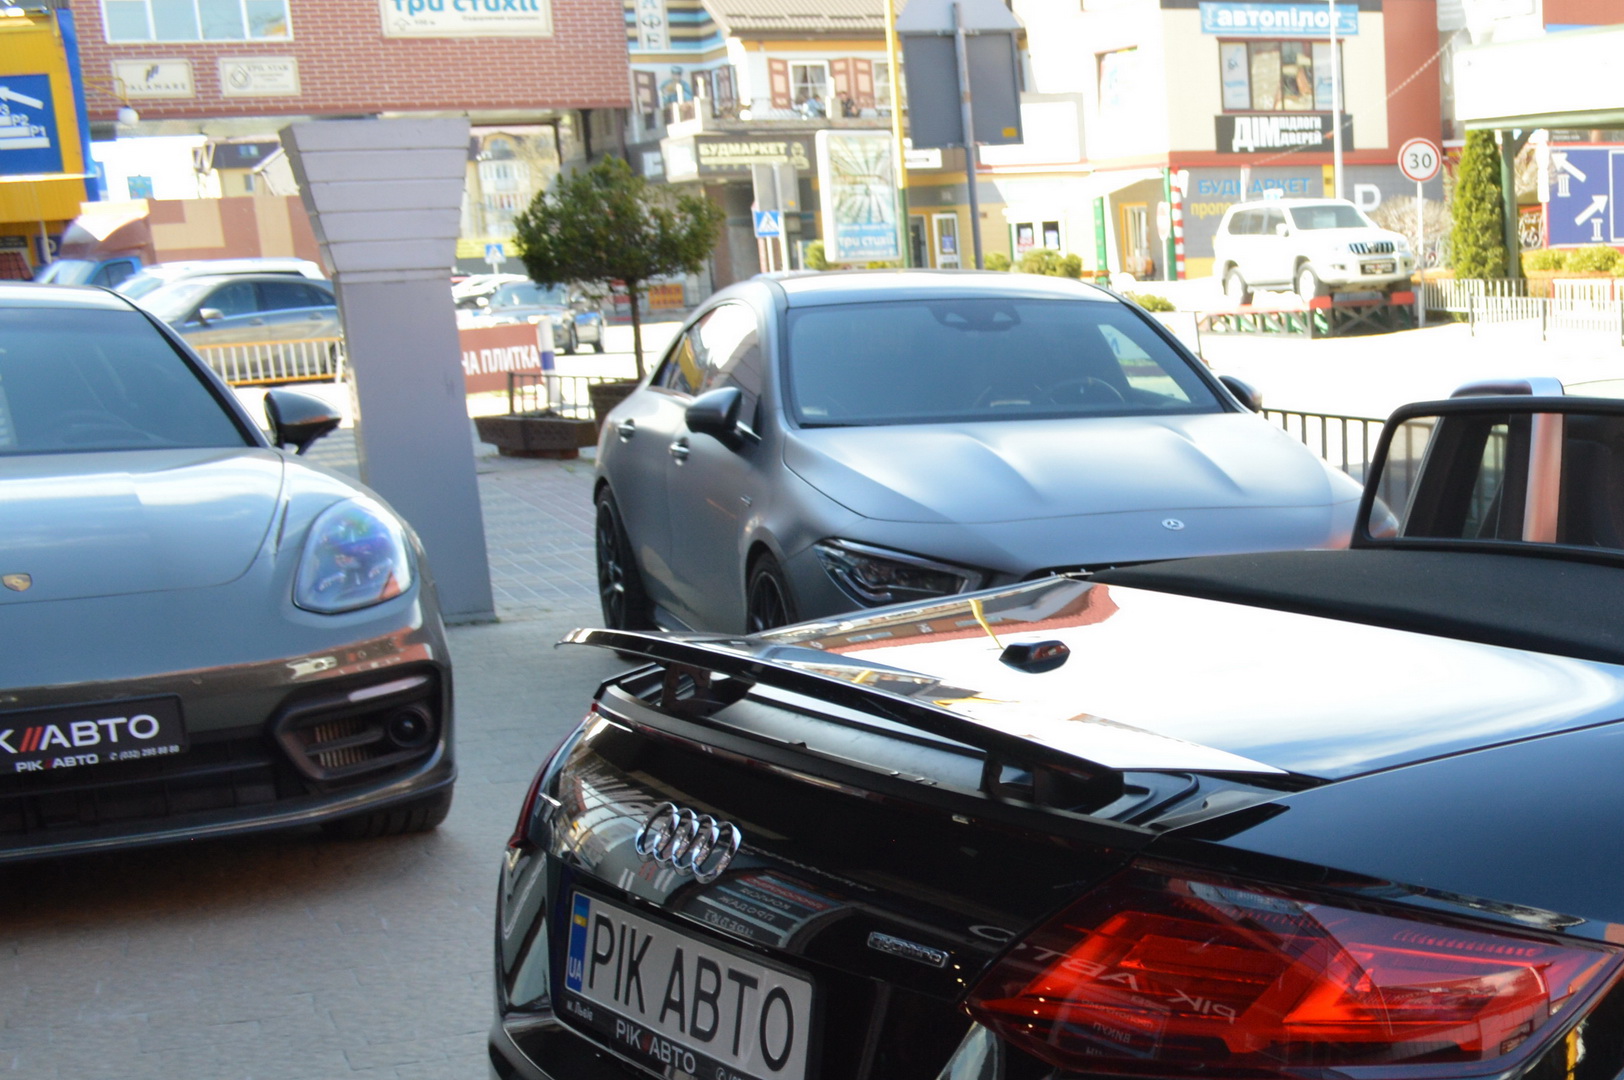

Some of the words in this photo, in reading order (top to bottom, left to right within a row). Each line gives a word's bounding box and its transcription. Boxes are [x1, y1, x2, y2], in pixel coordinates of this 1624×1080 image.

[1217, 8, 1341, 27] автопілот
[11, 114, 29, 125] P2
[1280, 116, 1322, 131] ПІДЛОГИ
[29, 125, 46, 137] P1
[1232, 117, 1280, 152] ДІМ
[1280, 131, 1323, 147] ДВЕРЕЙ
[699, 142, 787, 157] БУДМАРКЕТ
[1410, 153, 1432, 169] 30
[1198, 178, 1310, 196] БУДАРКЕТ
[481, 344, 541, 374] ПЛИТКА
[569, 955, 582, 982] UA
[588, 912, 653, 1014] РІК
[660, 944, 795, 1072] АВТО
[615, 1020, 641, 1049] РІК
[649, 1035, 696, 1074] АВТО
